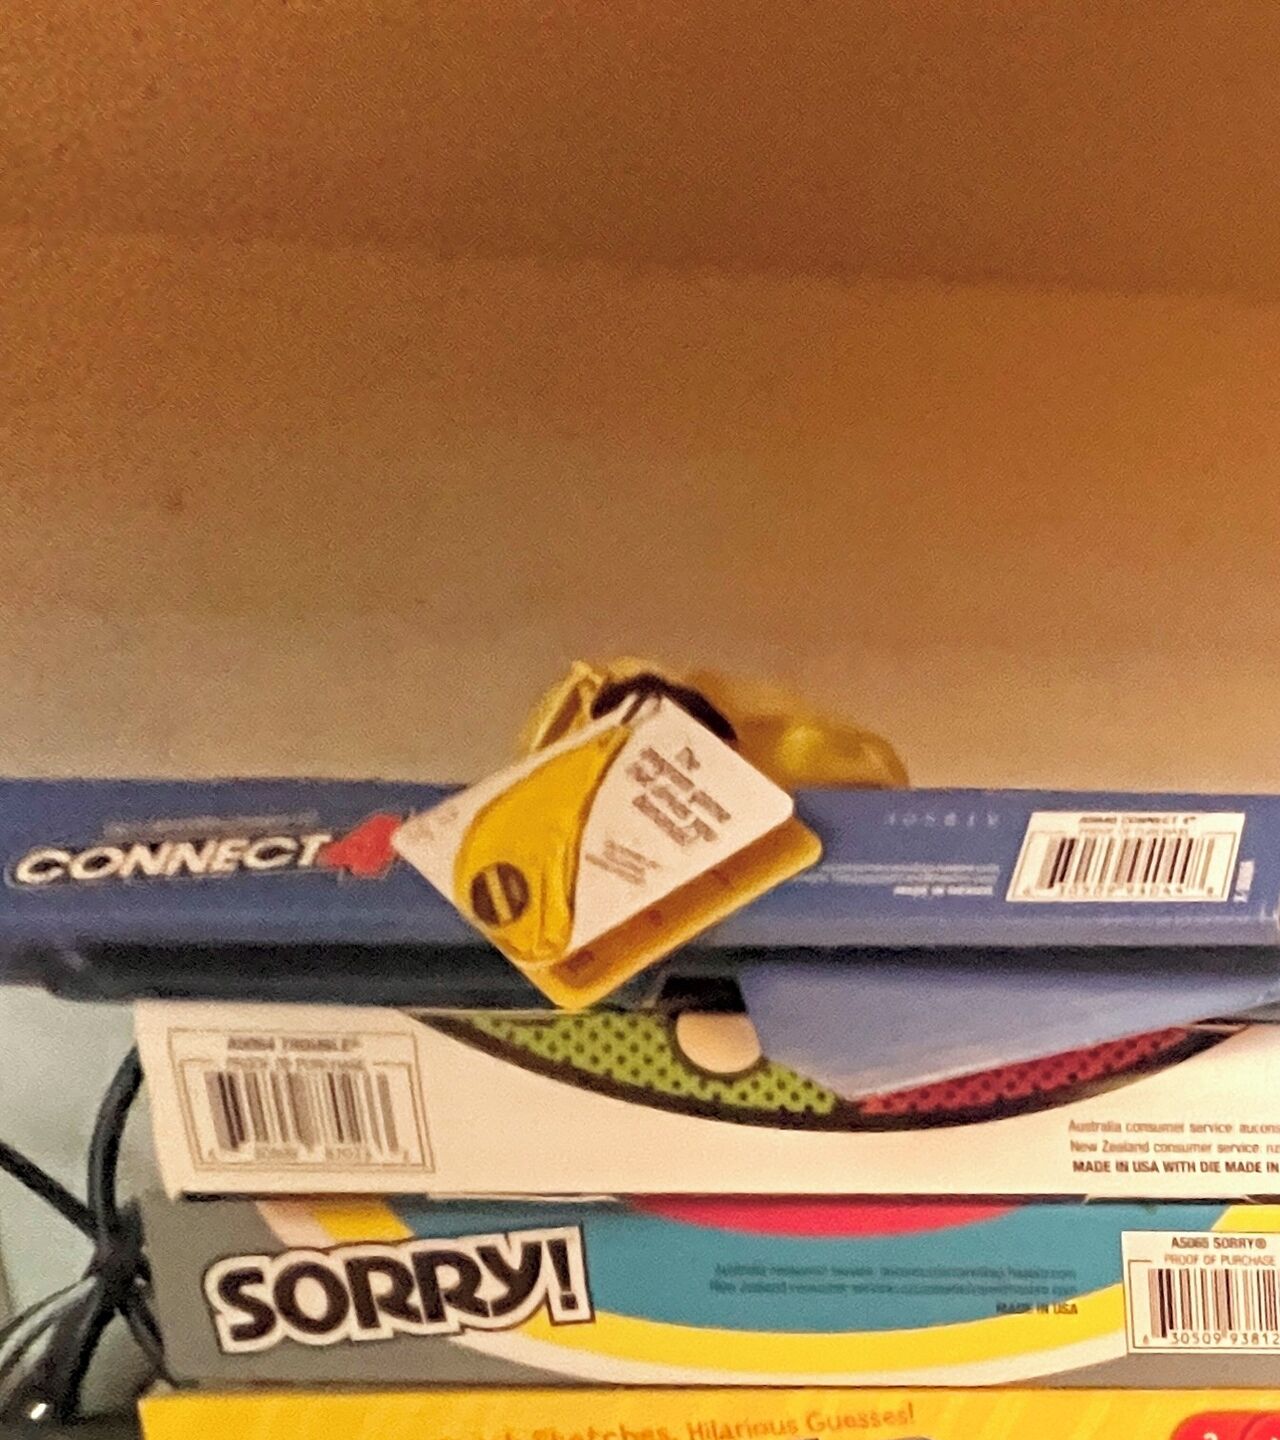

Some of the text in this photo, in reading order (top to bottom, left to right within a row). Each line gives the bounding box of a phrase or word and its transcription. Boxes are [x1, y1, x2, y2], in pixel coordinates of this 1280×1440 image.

[14, 832, 332, 885] CONNECT
[1068, 1119, 1122, 1133] Australia
[1125, 1122, 1185, 1133] consumer
[1070, 1139, 1098, 1153] New
[1102, 1139, 1150, 1153] Zealand
[1153, 1142, 1213, 1154] consumer
[1072, 1160, 1112, 1174] MADE
[1115, 1160, 1129, 1173] IN
[1132, 1160, 1160, 1173] USA
[1162, 1160, 1197, 1173] WITH
[1200, 1160, 1222, 1173] DIE
[1224, 1160, 1262, 1173] MADE
[1266, 1160, 1280, 1173] IN
[1164, 1253, 1277, 1266] PROOF OF PURCHASE
[212, 1236, 585, 1346] SORRY!
[1034, 1302, 1049, 1314] IN
[1051, 1303, 1079, 1314] USA
[1171, 1332, 1280, 1345] 30509 93812
[805, 1402, 915, 1433] Guesses!
